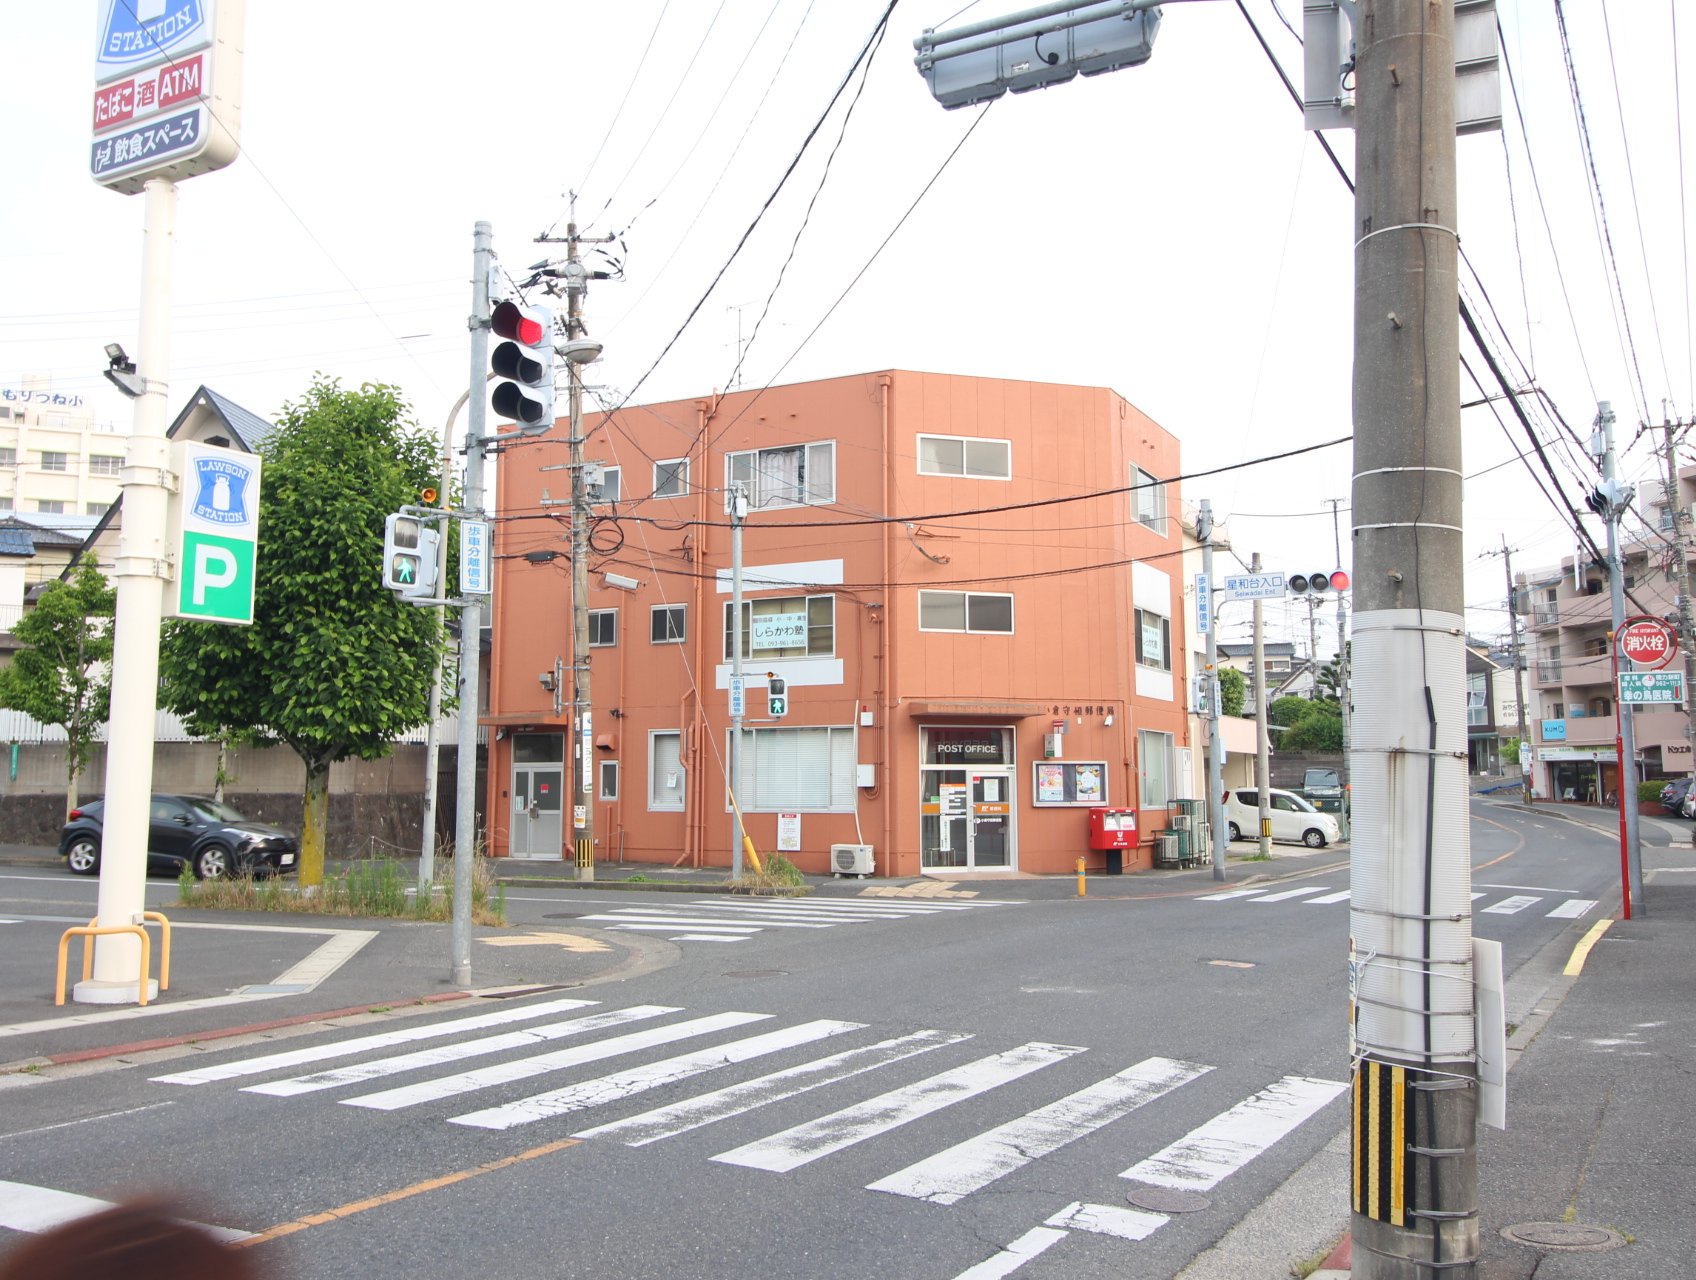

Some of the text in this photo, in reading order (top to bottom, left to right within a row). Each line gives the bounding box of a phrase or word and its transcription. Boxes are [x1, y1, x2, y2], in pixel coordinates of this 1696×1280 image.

[109, 5, 192, 52] STATION
[95, 63, 199, 123] たばこ 酒 ATM
[114, 117, 195, 164] 飲食スペース
[2, 389, 83, 407] もりつね小
[199, 461, 247, 480] LAWSON
[197, 503, 244, 523] STATION
[467, 526, 481, 588] 歩車分離信号
[192, 543, 238, 606] P
[1227, 576, 1283, 590] 星和台入口
[1234, 590, 1263, 598] Seiwadai
[1198, 576, 1208, 631] 歩車分離信号
[755, 624, 804, 638] しらかわ塾
[1626, 635, 1665, 651] 消火栓
[1623, 689, 1673, 701] 幸の鳥医院
[1047, 705, 1115, 716] 倉守恒郵便局
[937, 744, 997, 753] POST OFFICE
